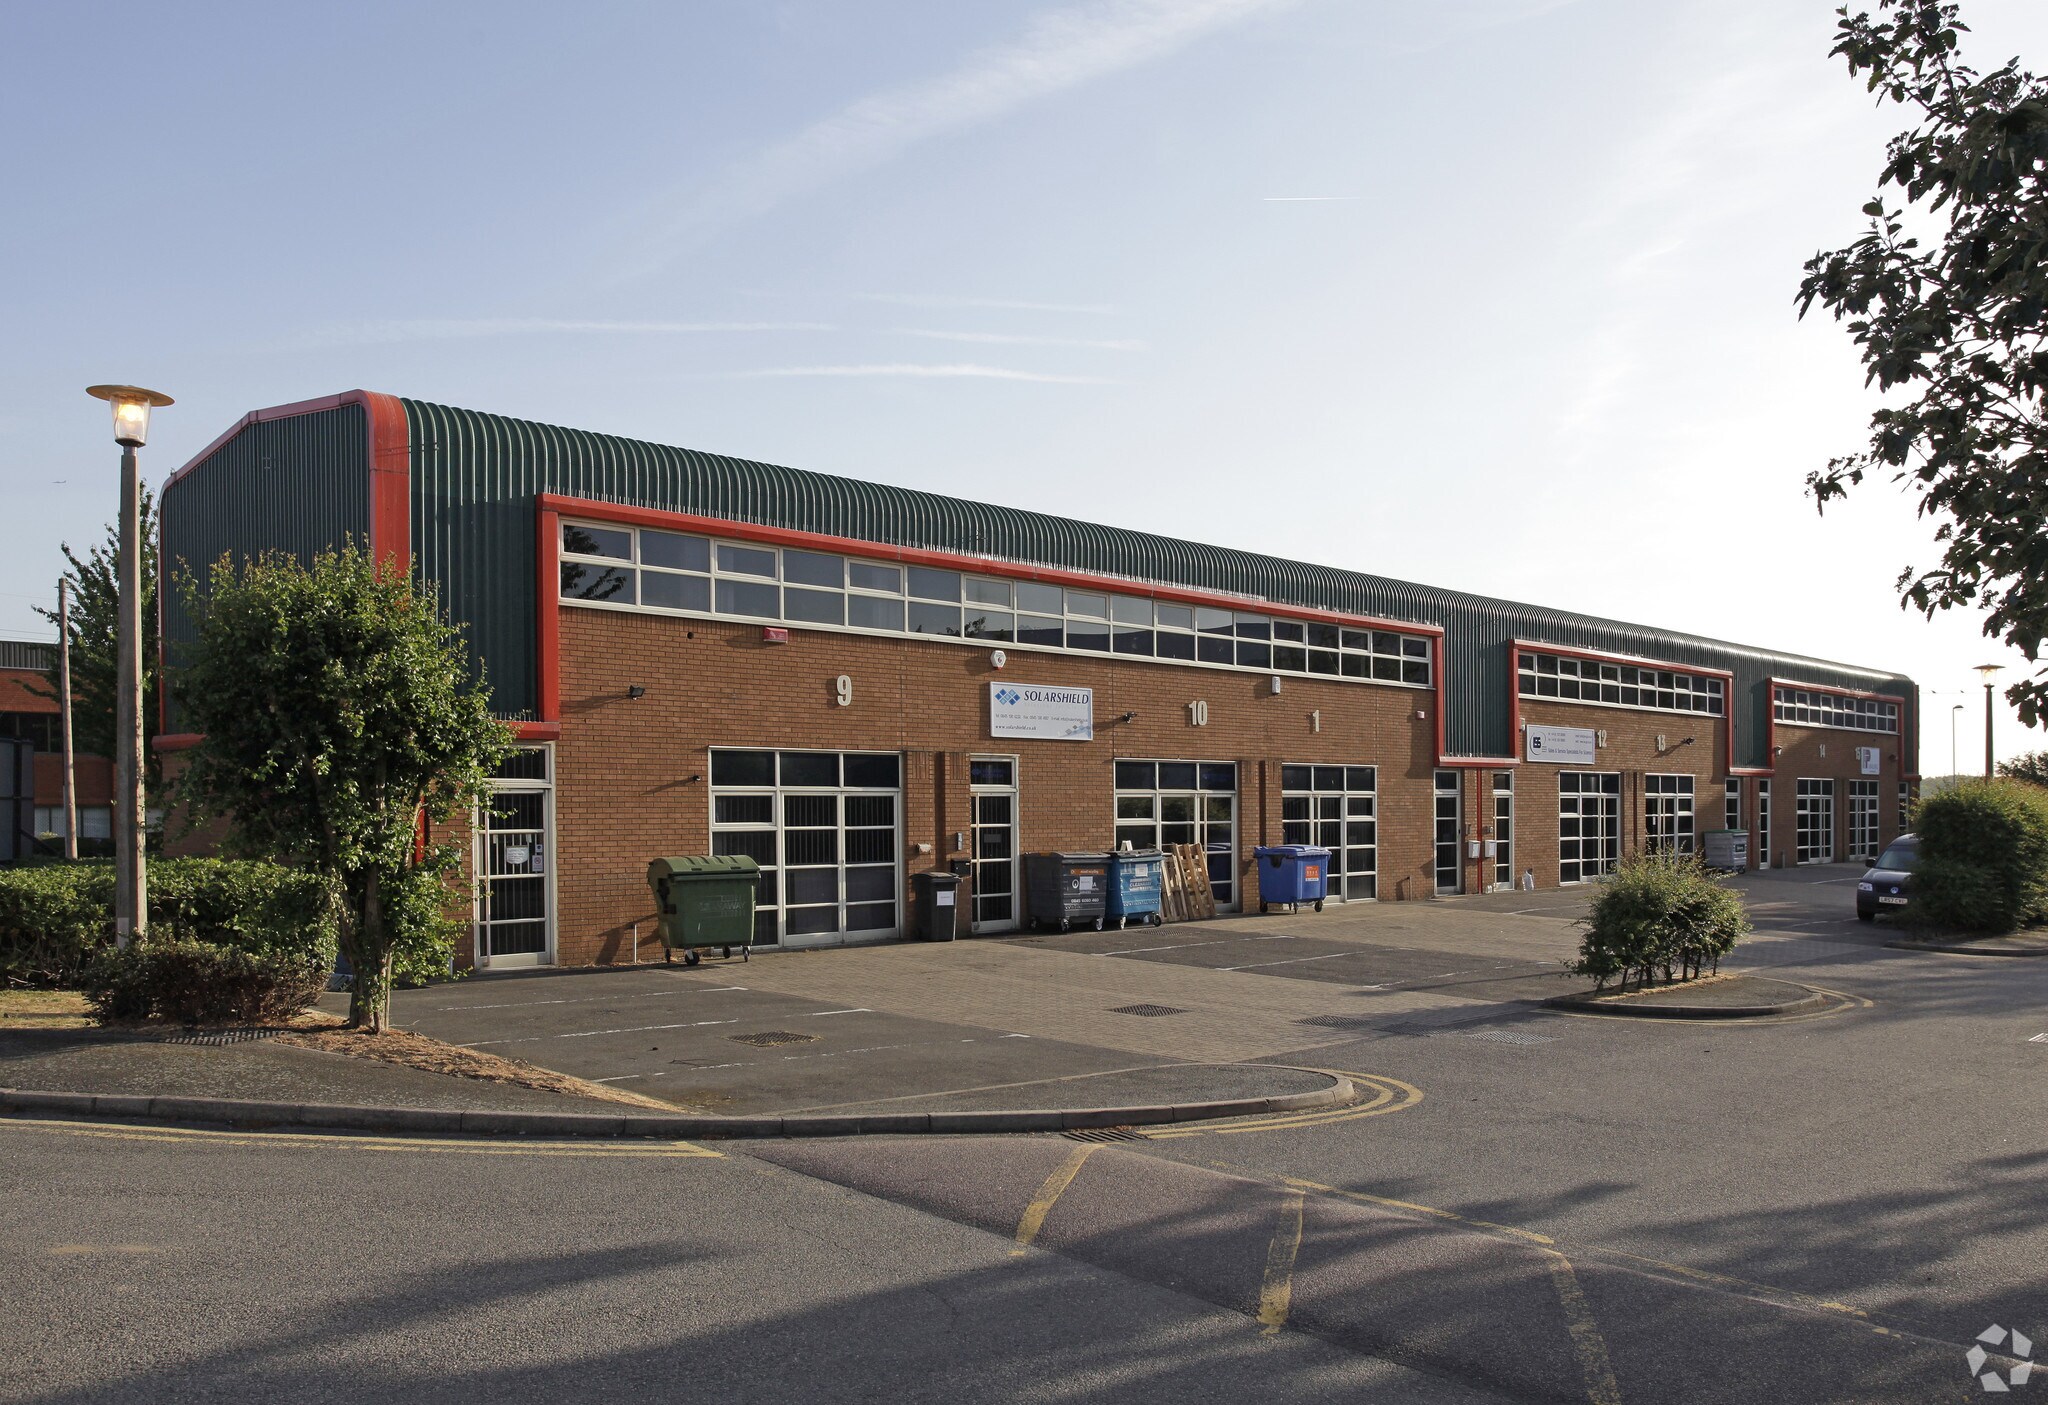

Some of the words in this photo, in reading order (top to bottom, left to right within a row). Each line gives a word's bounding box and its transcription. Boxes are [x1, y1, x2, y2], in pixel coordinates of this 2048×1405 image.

[836, 674, 852, 707] 9
[1024, 690, 1089, 704] SOLARSHIELD
[1188, 700, 1208, 726] 10
[1312, 709, 1320, 732] 1
[1597, 729, 1608, 748] 12
[1657, 734, 1666, 751] 13
[1819, 743, 1826, 758] 14
